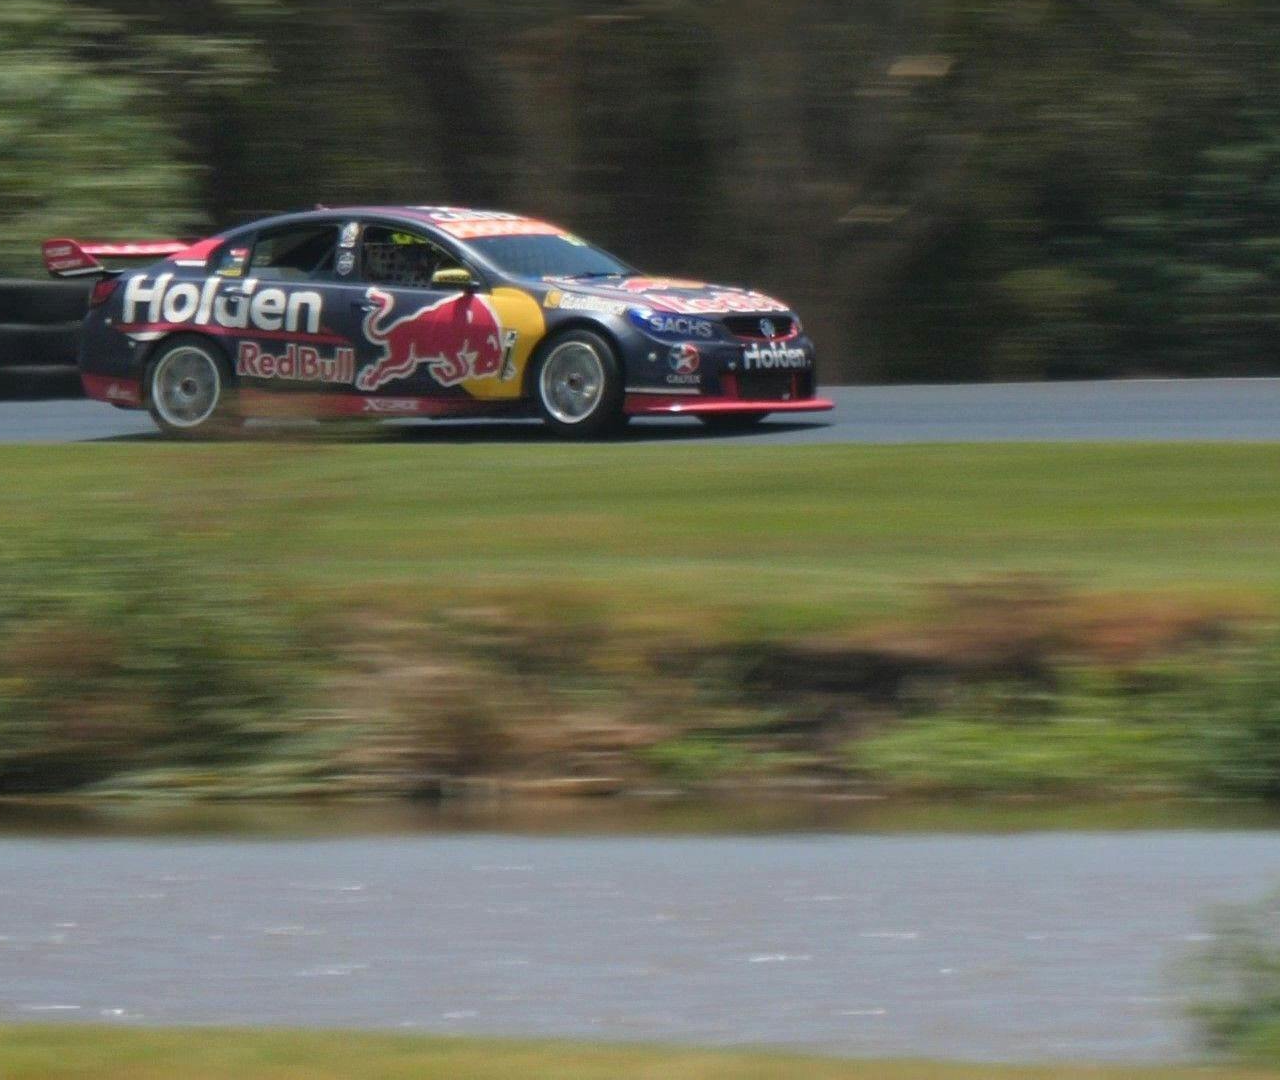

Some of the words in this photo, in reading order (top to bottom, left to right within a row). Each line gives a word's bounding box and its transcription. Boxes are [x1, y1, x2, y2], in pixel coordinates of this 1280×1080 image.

[123, 272, 323, 334] Holden
[650, 316, 713, 338] SACHS
[236, 341, 297, 379] Red
[298, 346, 355, 384] Bull
[744, 342, 806, 370] Holden
